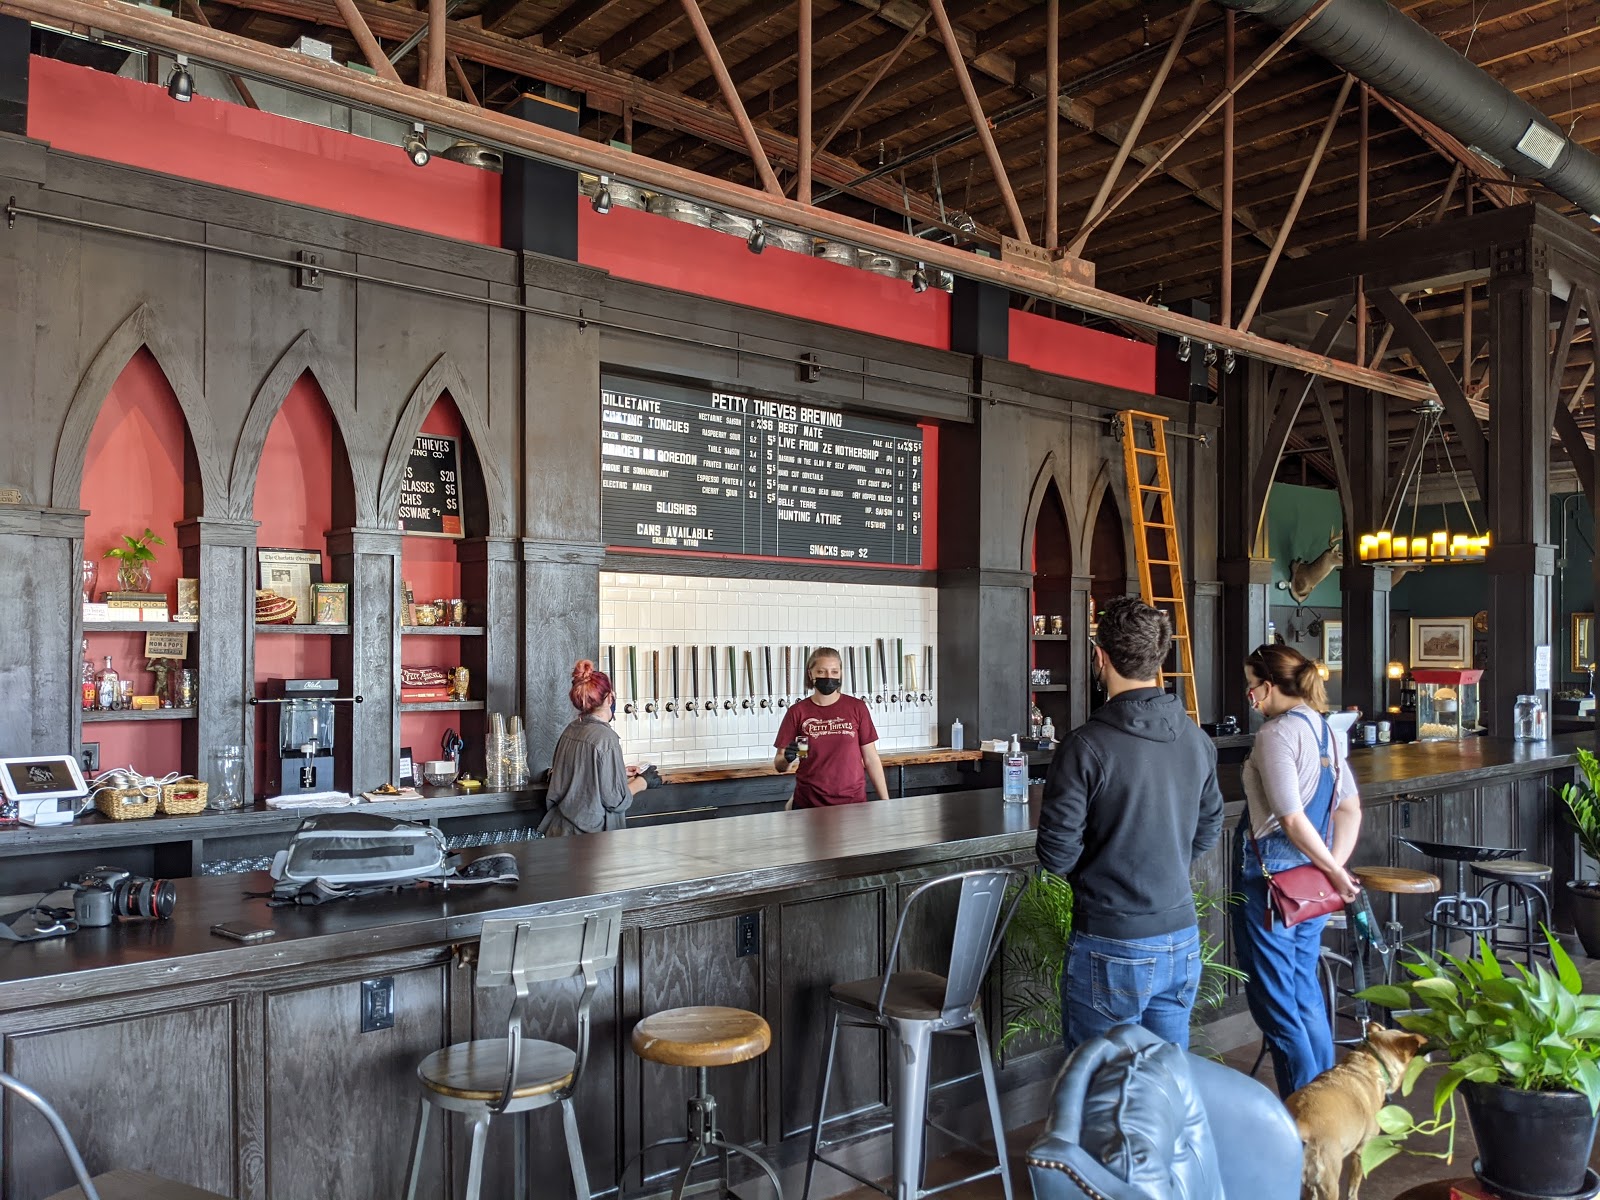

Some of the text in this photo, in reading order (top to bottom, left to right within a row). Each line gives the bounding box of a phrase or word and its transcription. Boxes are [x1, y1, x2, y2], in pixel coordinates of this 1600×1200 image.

[603, 393, 660, 413] DILLETANTE
[712, 393, 842, 427] PETTY THIEVES BREWING
[648, 417, 689, 433] TONGUES
[779, 422, 798, 434] BEST
[417, 438, 449, 452] THIEVES
[779, 437, 795, 449] LIVE
[799, 440, 818, 452] FROM
[823, 443, 832, 454] ZE
[440, 470, 454, 482] $20
[913, 469, 917, 478] 7
[446, 484, 455, 495] $5
[446, 499, 457, 510] $5
[778, 498, 794, 507] BELLE
[913, 496, 917, 504] 6
[657, 502, 697, 516] SLUSHIES
[779, 509, 810, 522] HUNTING
[816, 513, 841, 525] ATTIRE
[913, 525, 917, 534] 6
[637, 523, 713, 540] CANS AVAILABLE
[810, 545, 838, 556] SNACKS
